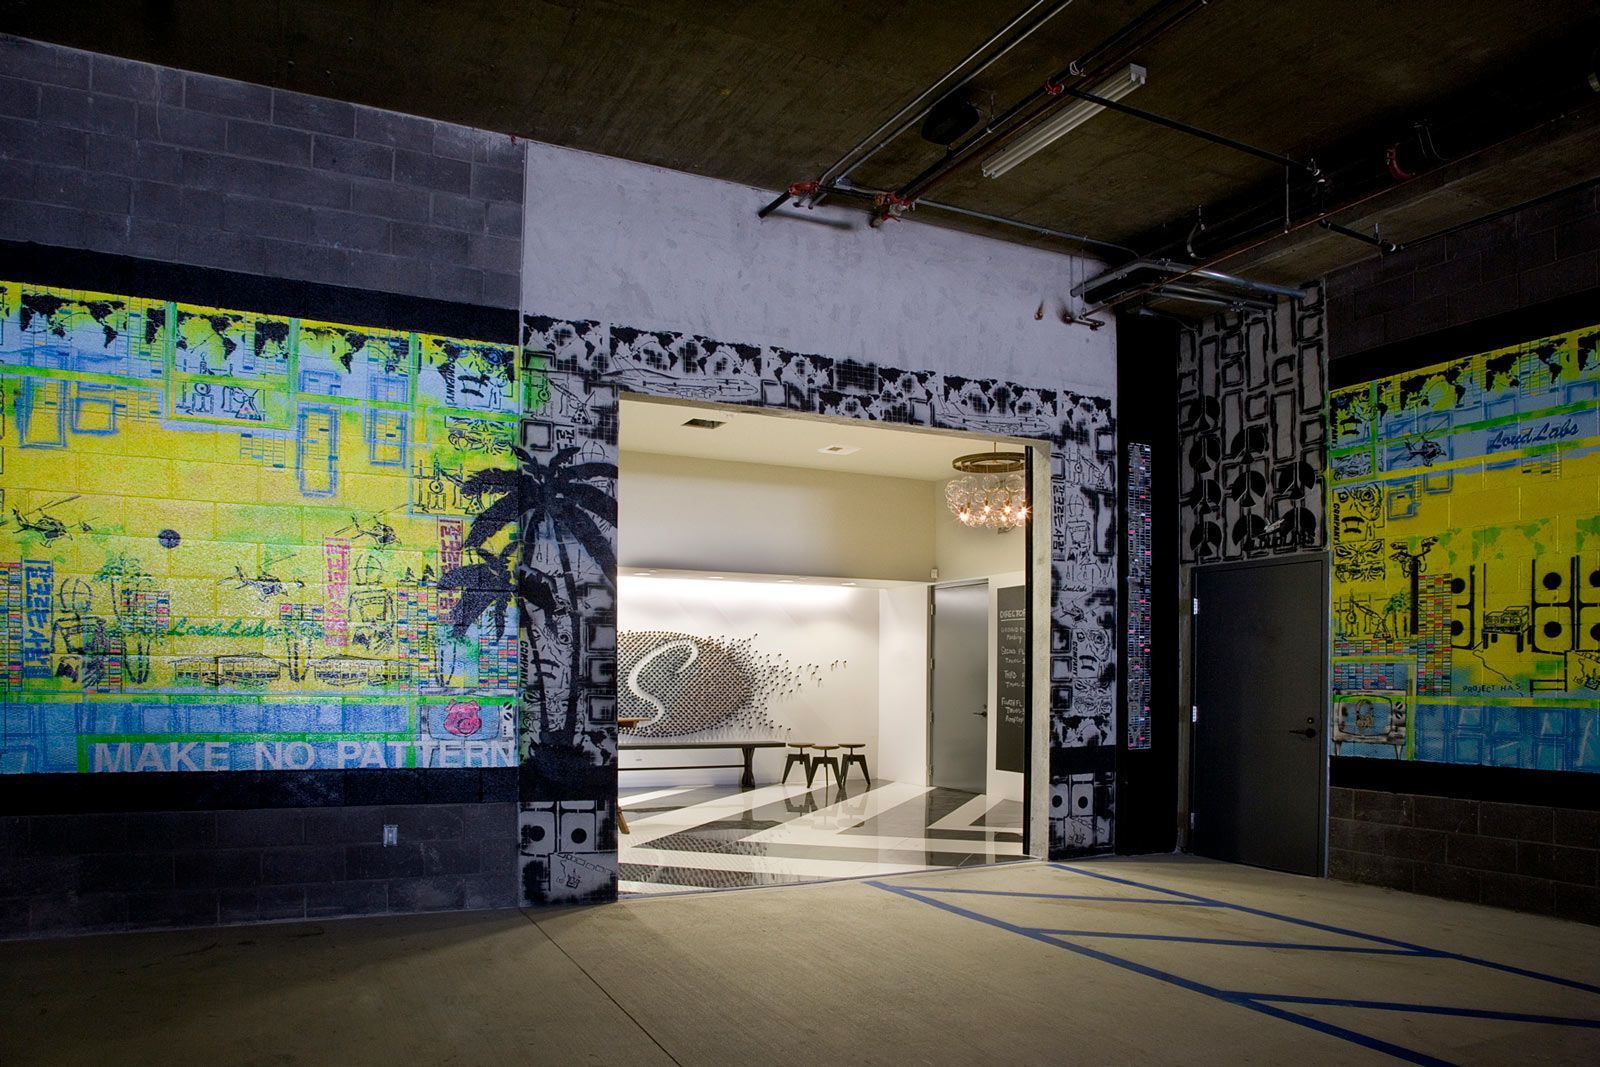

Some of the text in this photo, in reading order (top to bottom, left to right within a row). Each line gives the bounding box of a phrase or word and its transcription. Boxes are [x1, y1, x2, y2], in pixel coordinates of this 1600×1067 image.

[1488, 418, 1578, 449] Loud Labs
[1462, 684, 1495, 693] PROJECT
[94, 740, 514, 773] MAKE NO PATTERN
